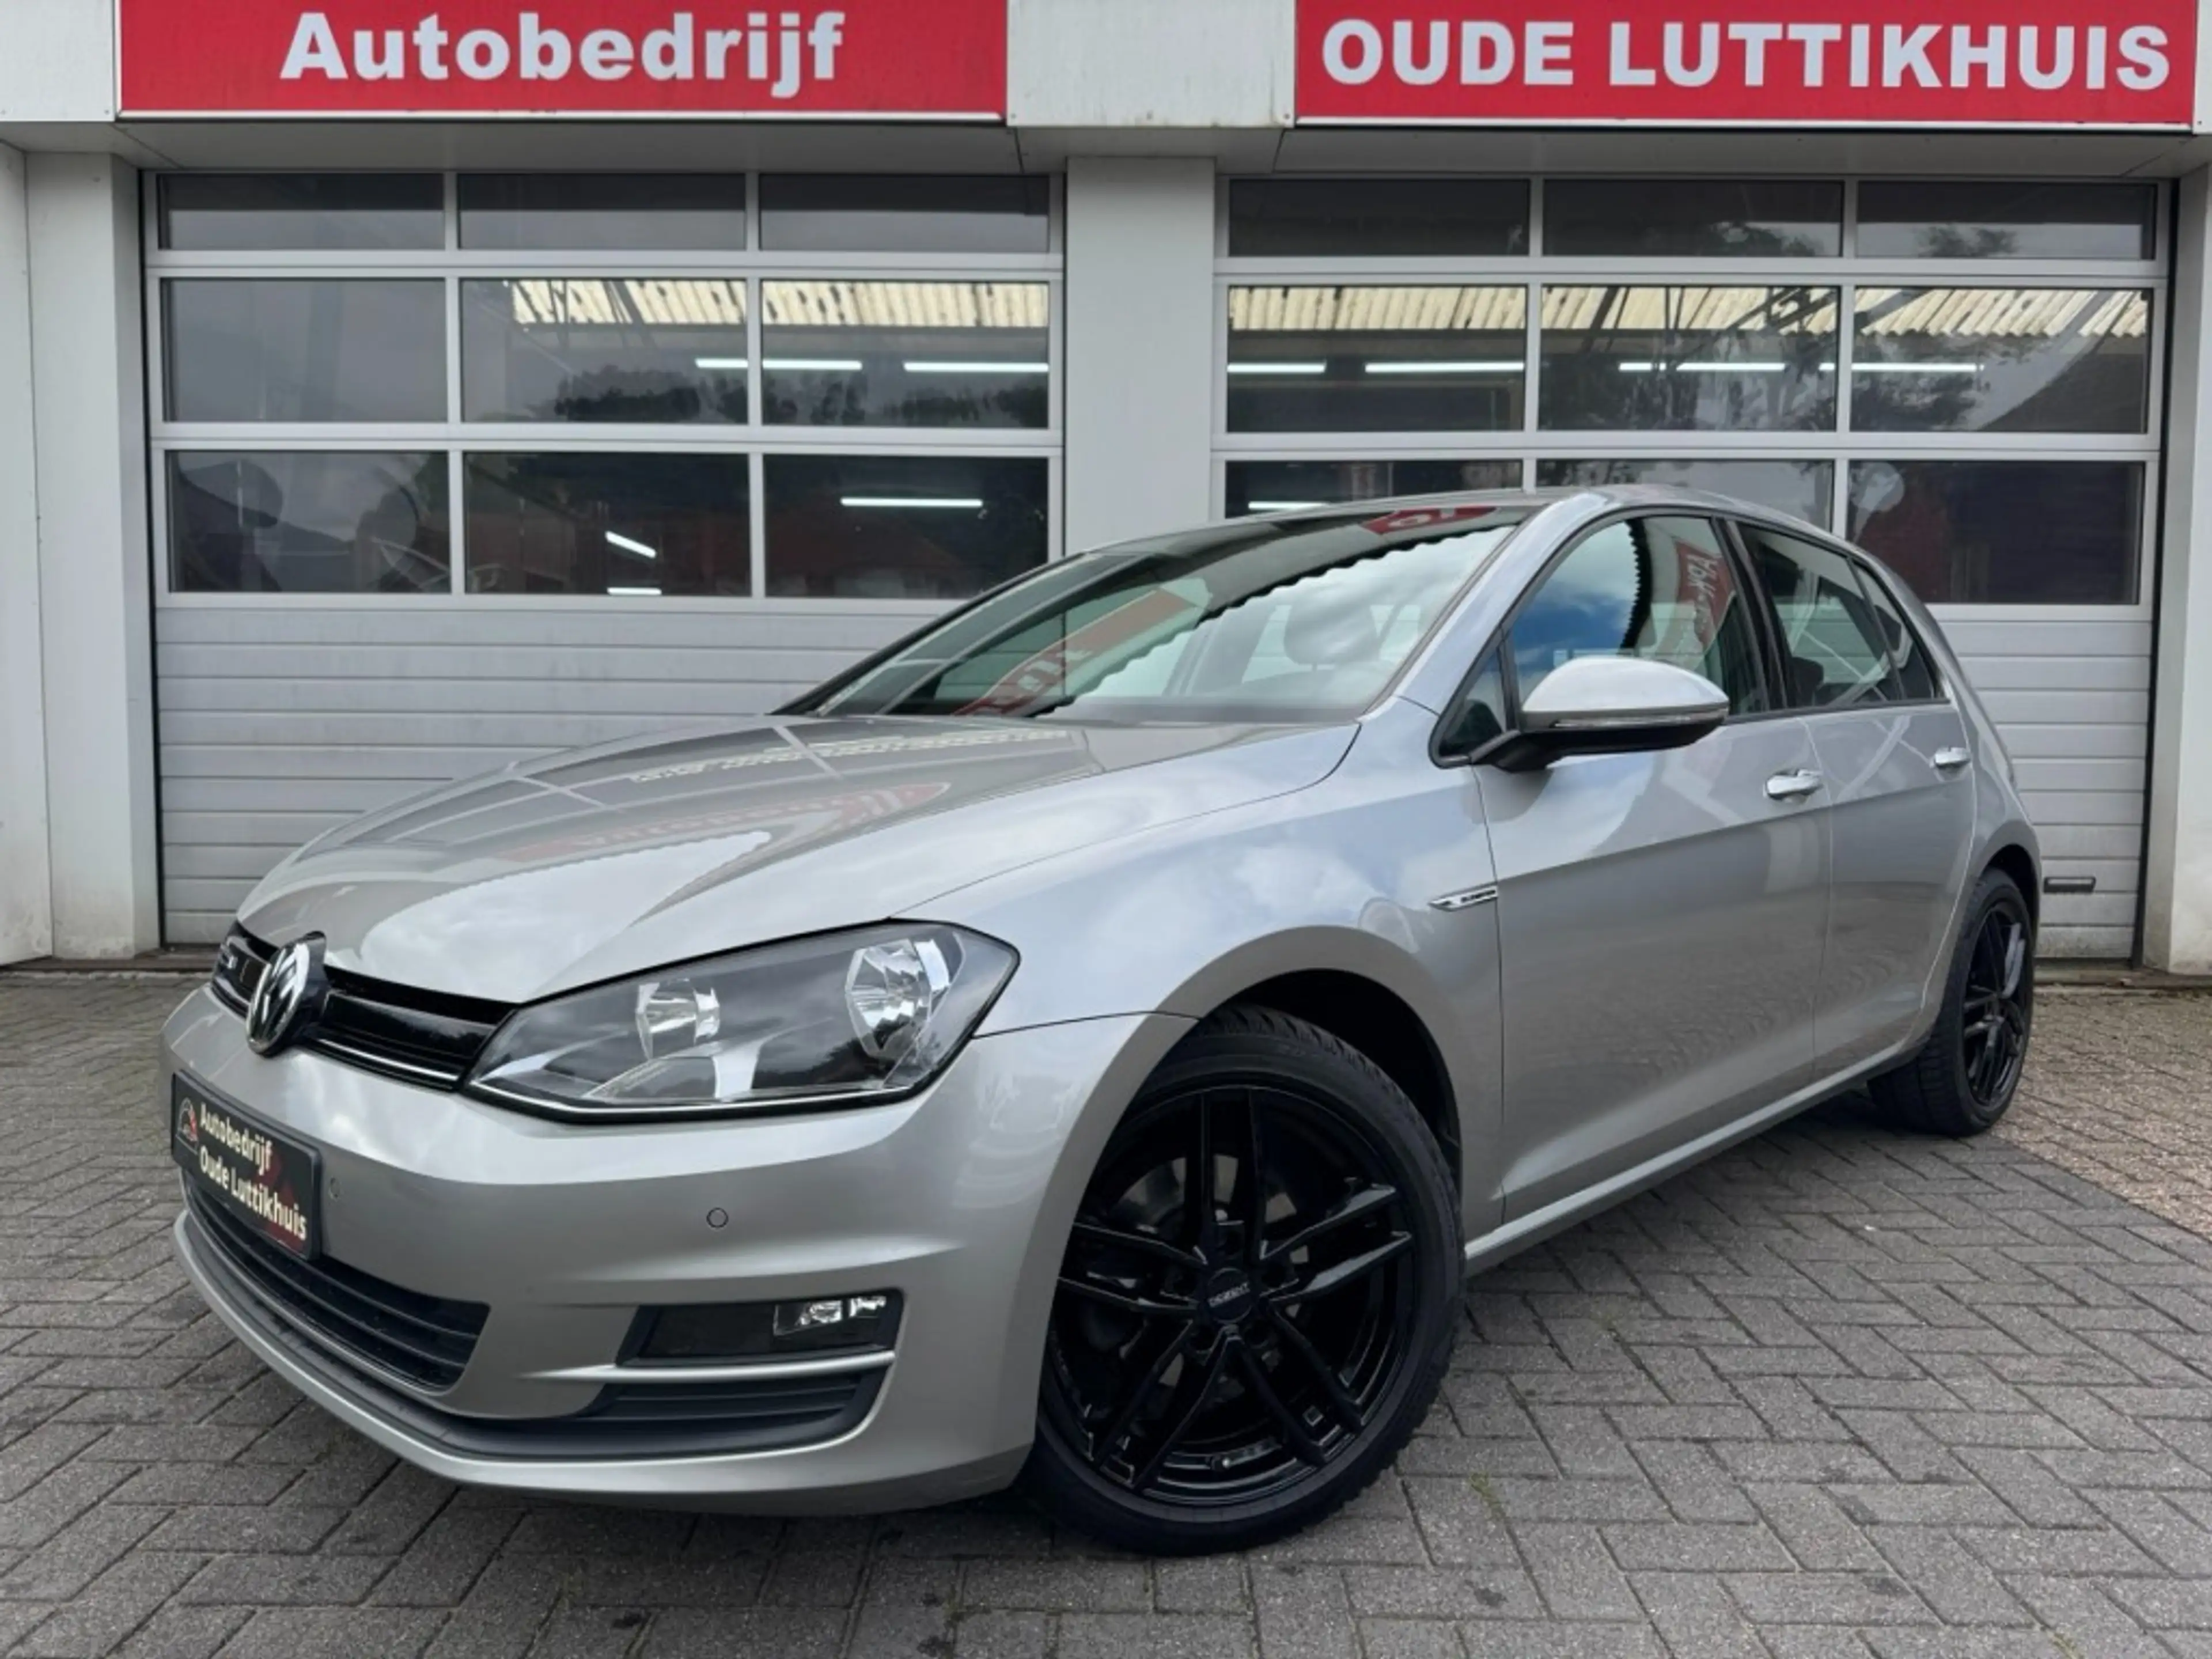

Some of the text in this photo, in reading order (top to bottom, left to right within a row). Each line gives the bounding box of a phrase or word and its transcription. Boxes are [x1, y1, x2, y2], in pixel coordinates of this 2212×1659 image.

[280, 12, 844, 98] Autobedrijf
[1323, 19, 2169, 90] OUDE LUTTIKHUIS
[200, 1101, 273, 1176] Autobedrijf
[200, 1145, 307, 1241] Oude Luttikhuis
